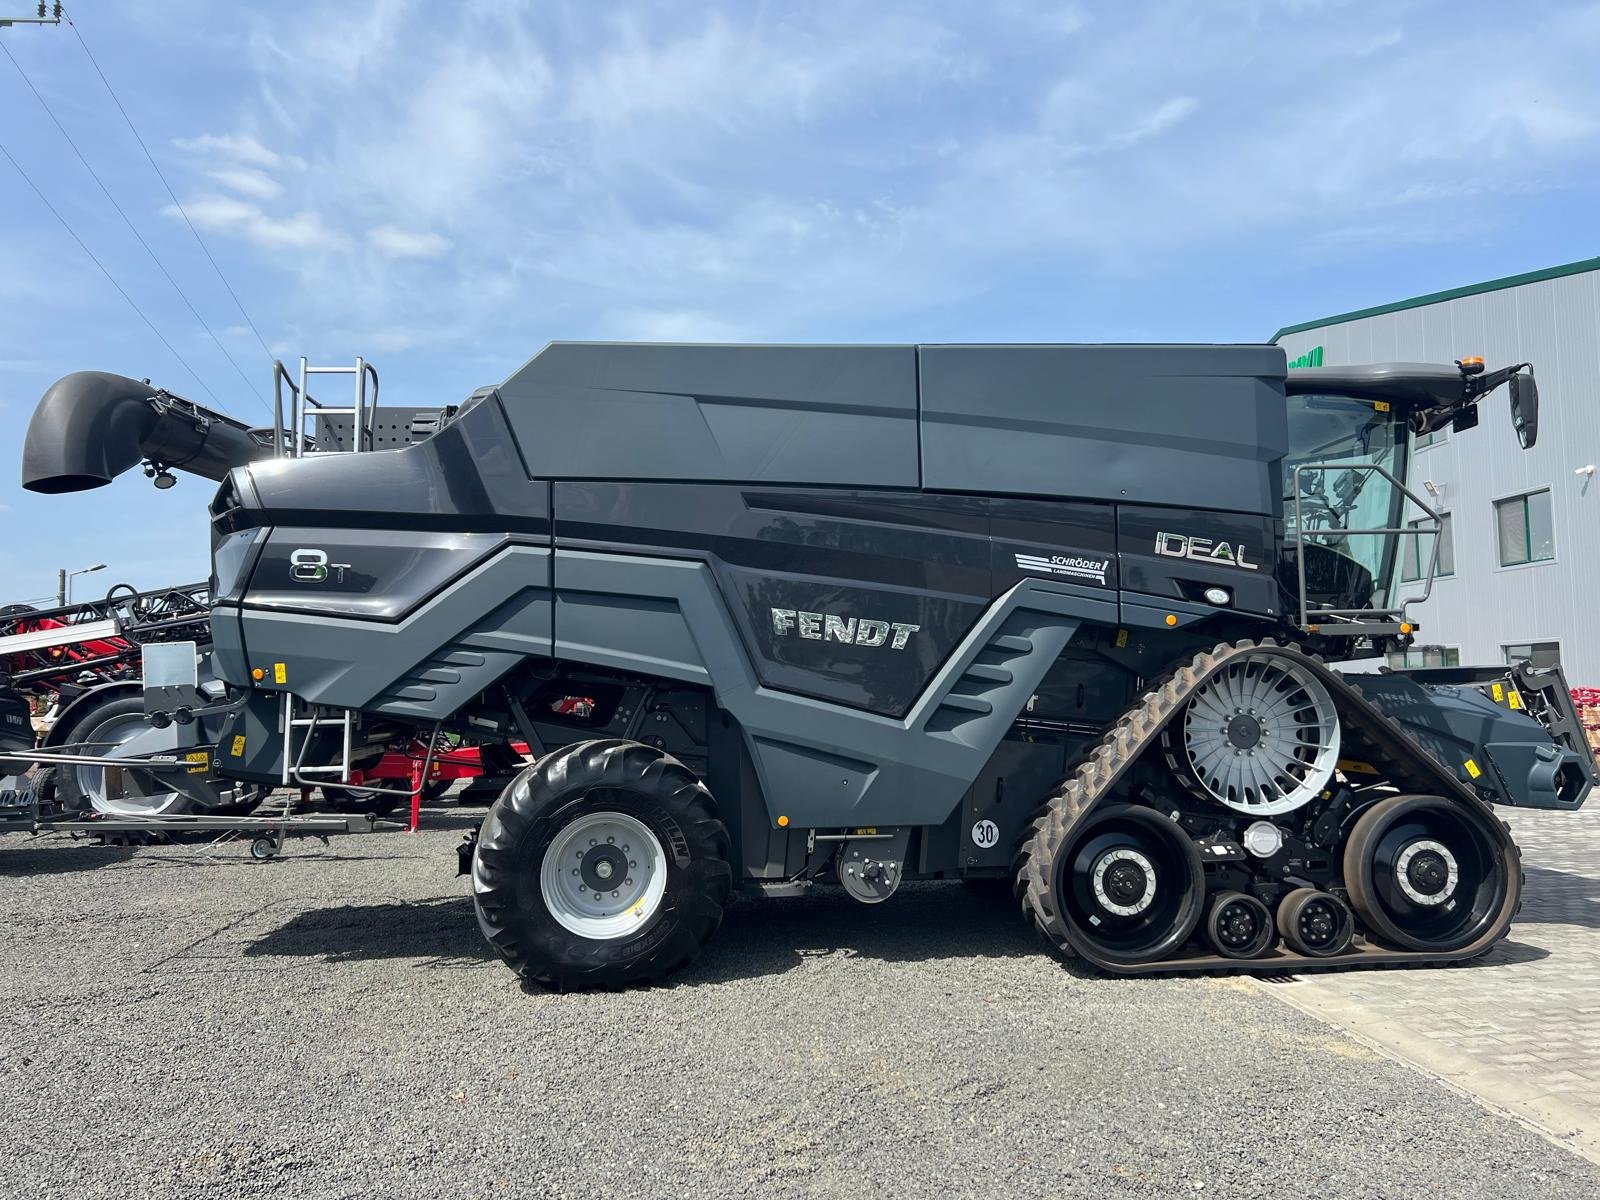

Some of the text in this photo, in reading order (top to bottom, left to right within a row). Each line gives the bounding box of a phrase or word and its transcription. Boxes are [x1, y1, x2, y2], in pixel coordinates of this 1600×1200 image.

[1155, 531, 1258, 569] IDEAL
[1050, 556, 1101, 570] SCHRÖDER
[1053, 569, 1096, 579] LANDMASCHINEN
[771, 607, 921, 650] FENDT
[977, 824, 994, 844] 30
